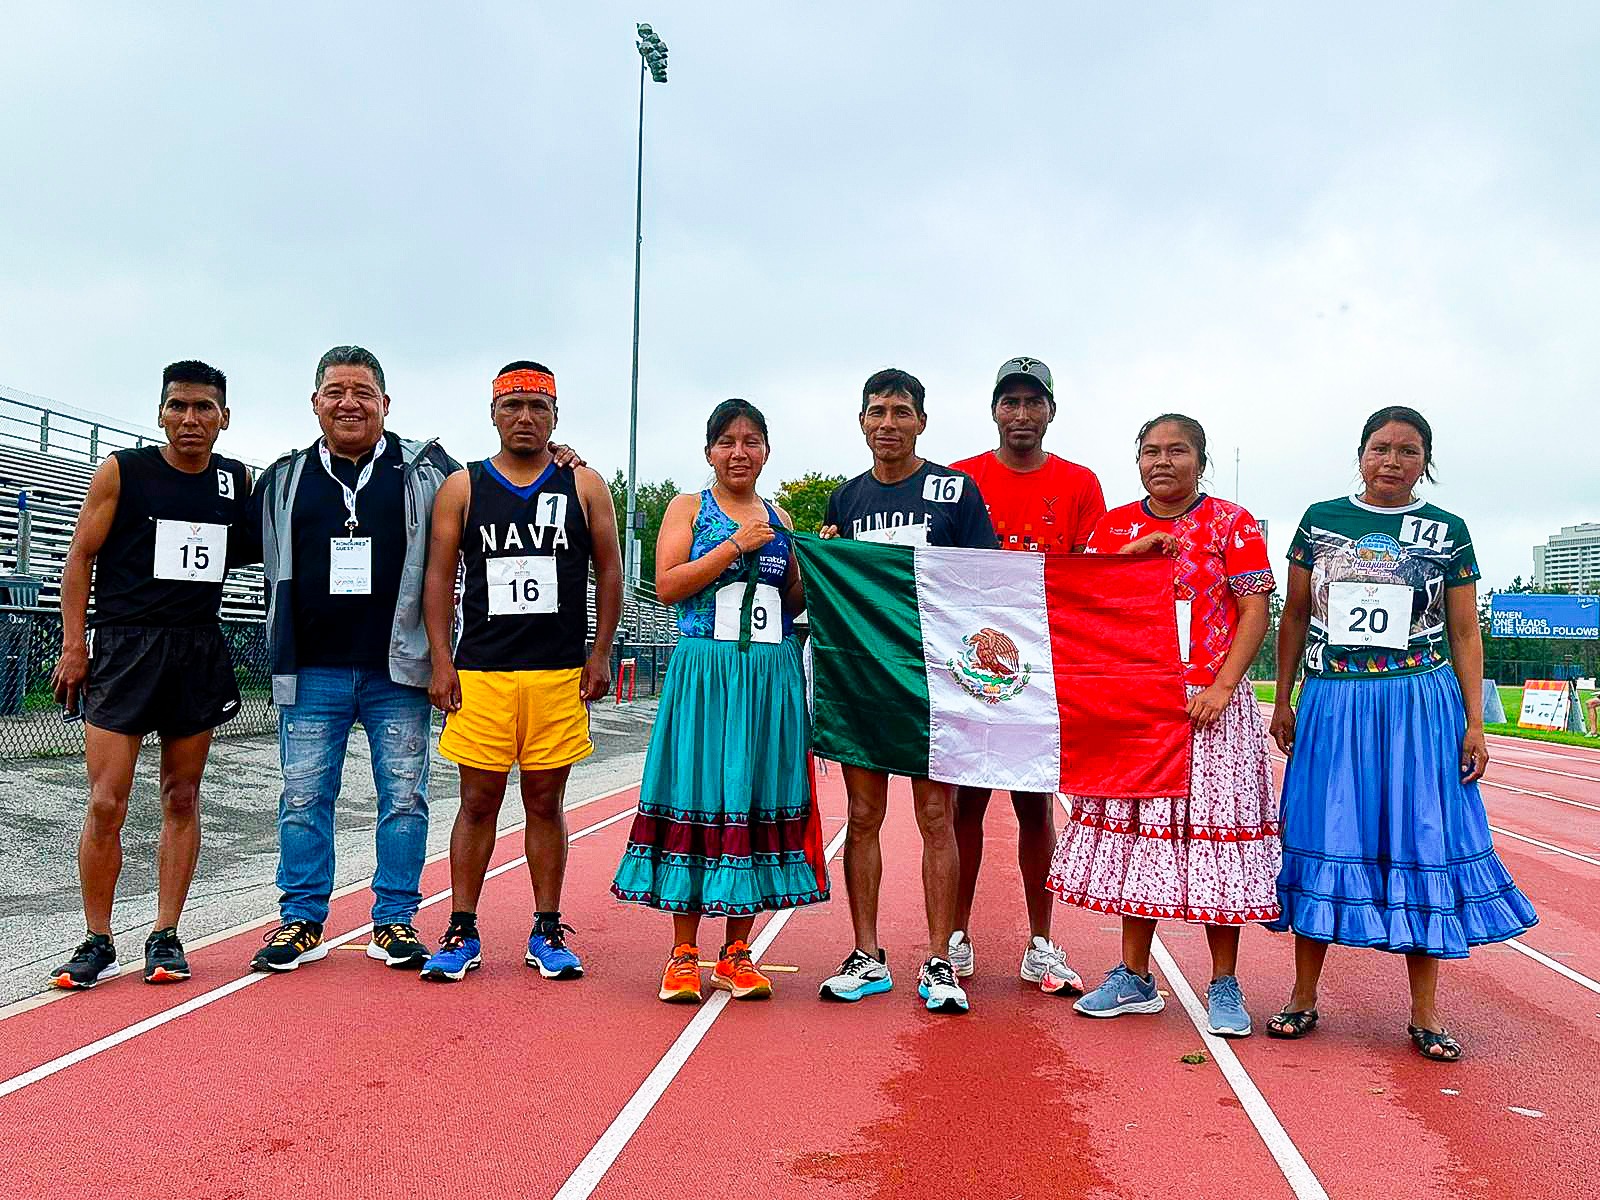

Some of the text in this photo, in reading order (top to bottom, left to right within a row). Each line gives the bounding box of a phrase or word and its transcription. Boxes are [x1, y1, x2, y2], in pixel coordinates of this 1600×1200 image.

[218, 471, 230, 496] 3
[931, 477, 957, 501] 16
[545, 495, 559, 525] 1
[479, 522, 569, 553] NAVA
[1410, 519, 1440, 548] 14
[179, 544, 210, 570] 15
[508, 578, 540, 603] 16
[1348, 606, 1389, 633] 20
[1493, 611, 1522, 619] WHEN
[1493, 619, 1547, 627] ONE LEADS
[1495, 626, 1599, 636] THE WORLD FOLLOWS
